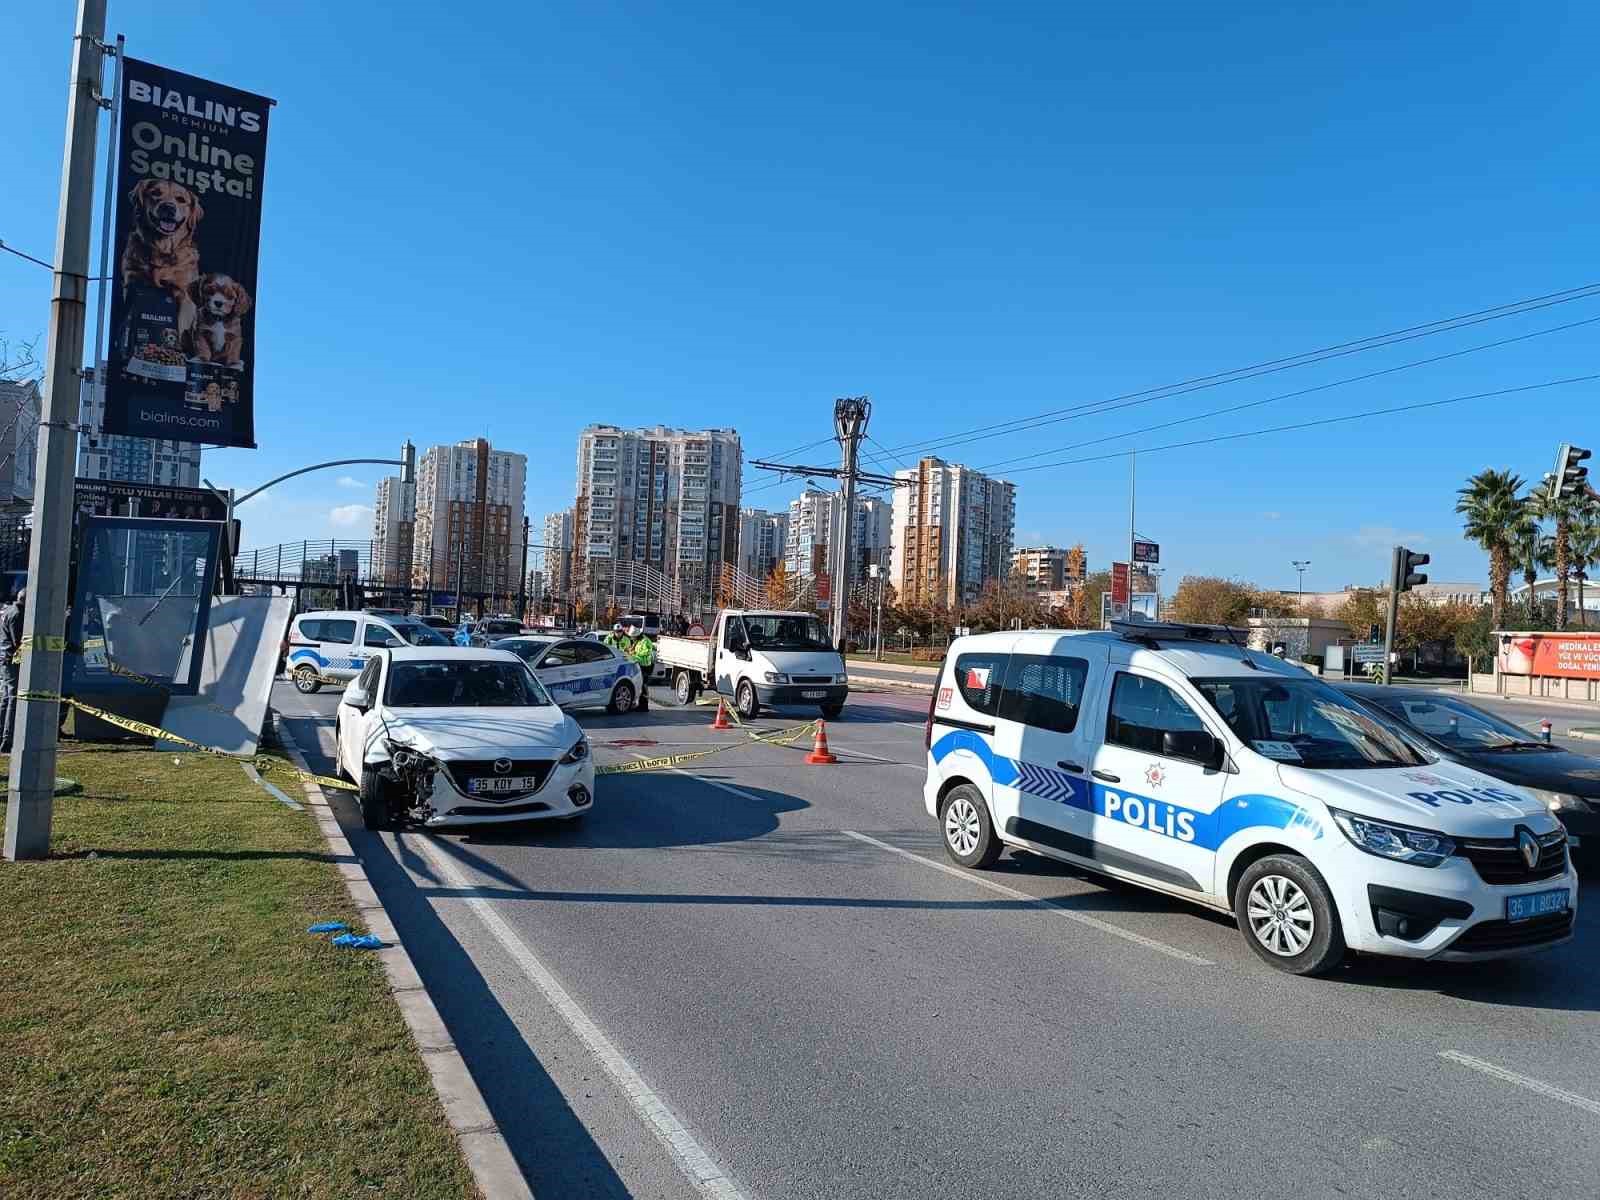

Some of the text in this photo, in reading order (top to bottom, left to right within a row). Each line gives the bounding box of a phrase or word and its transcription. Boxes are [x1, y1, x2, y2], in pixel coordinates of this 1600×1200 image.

[129, 80, 260, 132] BIALIN'S
[131, 121, 254, 174] Online
[130, 150, 253, 199] Satışta!
[140, 409, 220, 428] bialins.com
